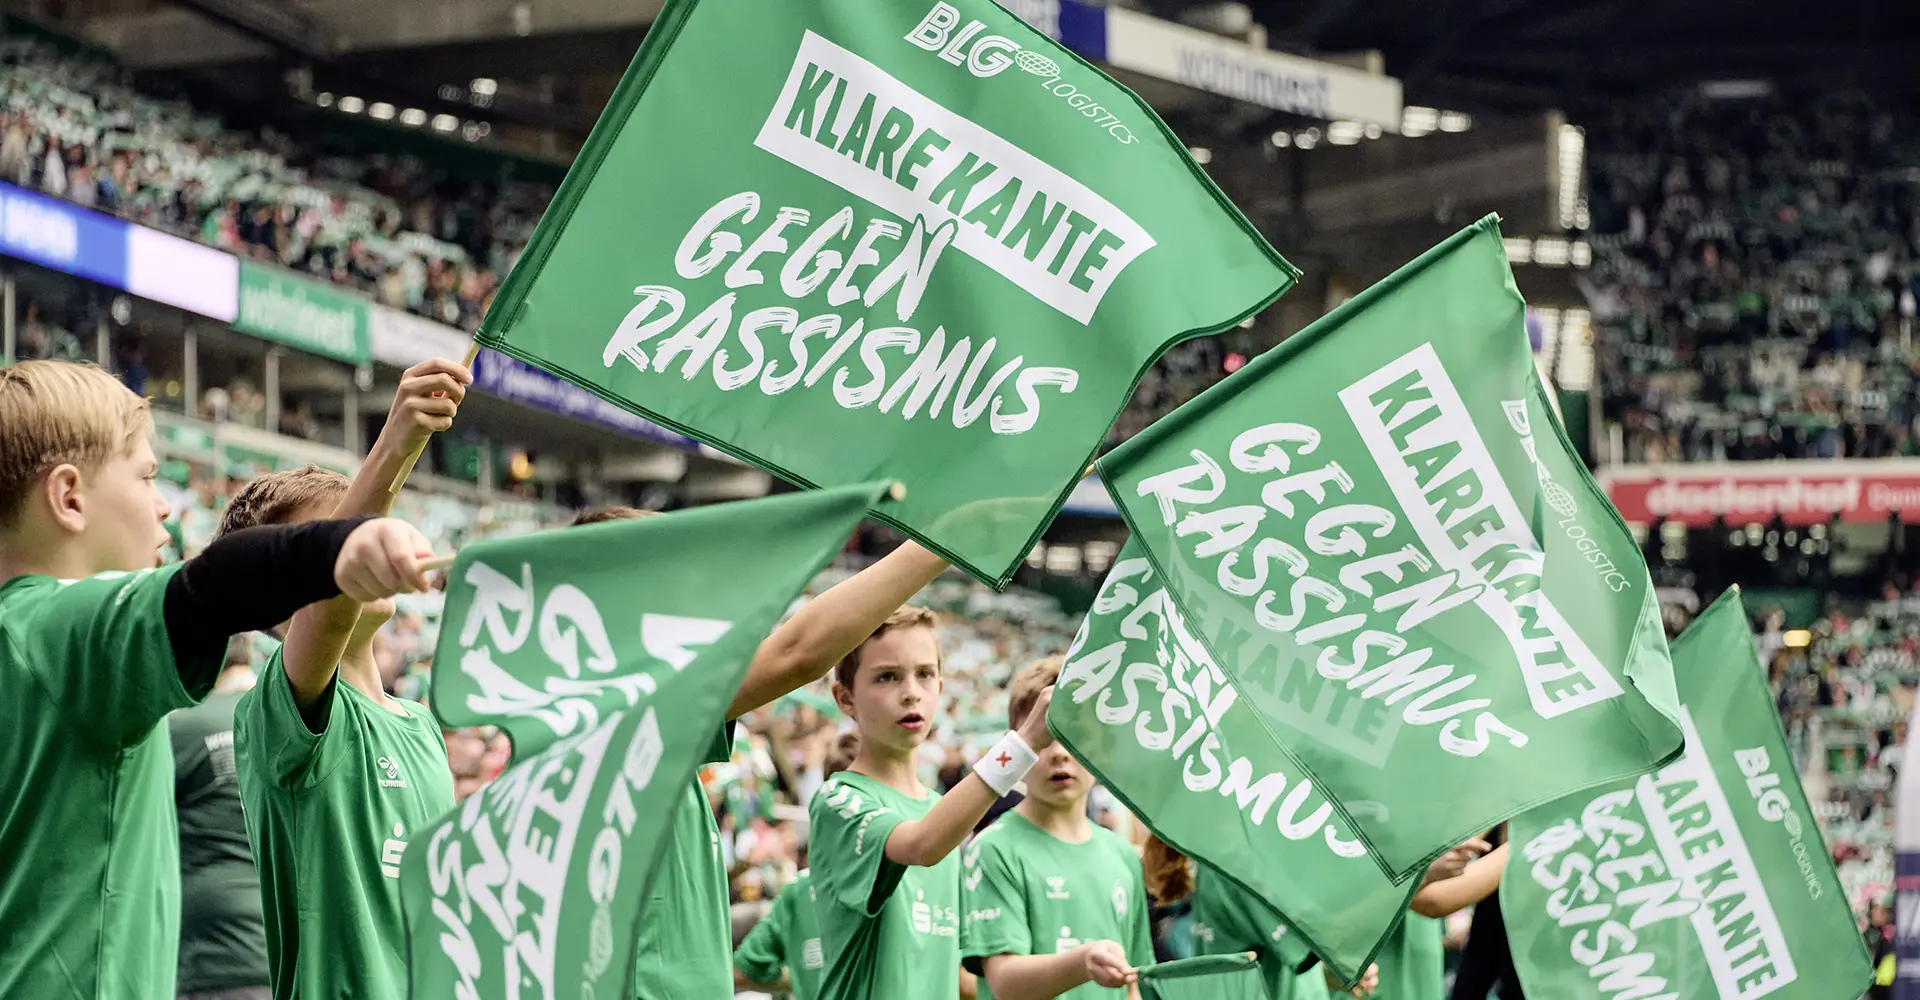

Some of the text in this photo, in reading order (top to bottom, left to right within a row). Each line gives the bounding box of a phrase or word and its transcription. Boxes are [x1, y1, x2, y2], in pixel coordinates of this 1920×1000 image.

[903, 1, 1022, 78] BLG
[1041, 74, 1140, 145] LOGISTICS
[674, 191, 959, 322] GEGEN
[784, 63, 1126, 294] KLARE KANTE
[603, 285, 1079, 435] RASSISMUS
[1137, 449, 1529, 758] RASSISMUS
[1229, 422, 1486, 632] GEGEN
[1368, 369, 1597, 705] KLARE KANTE
[1558, 516, 1632, 593] LOGISTICS
[1654, 776, 1778, 995] ARE KANTE
[1734, 746, 1824, 901] BLG LOGISTICS
